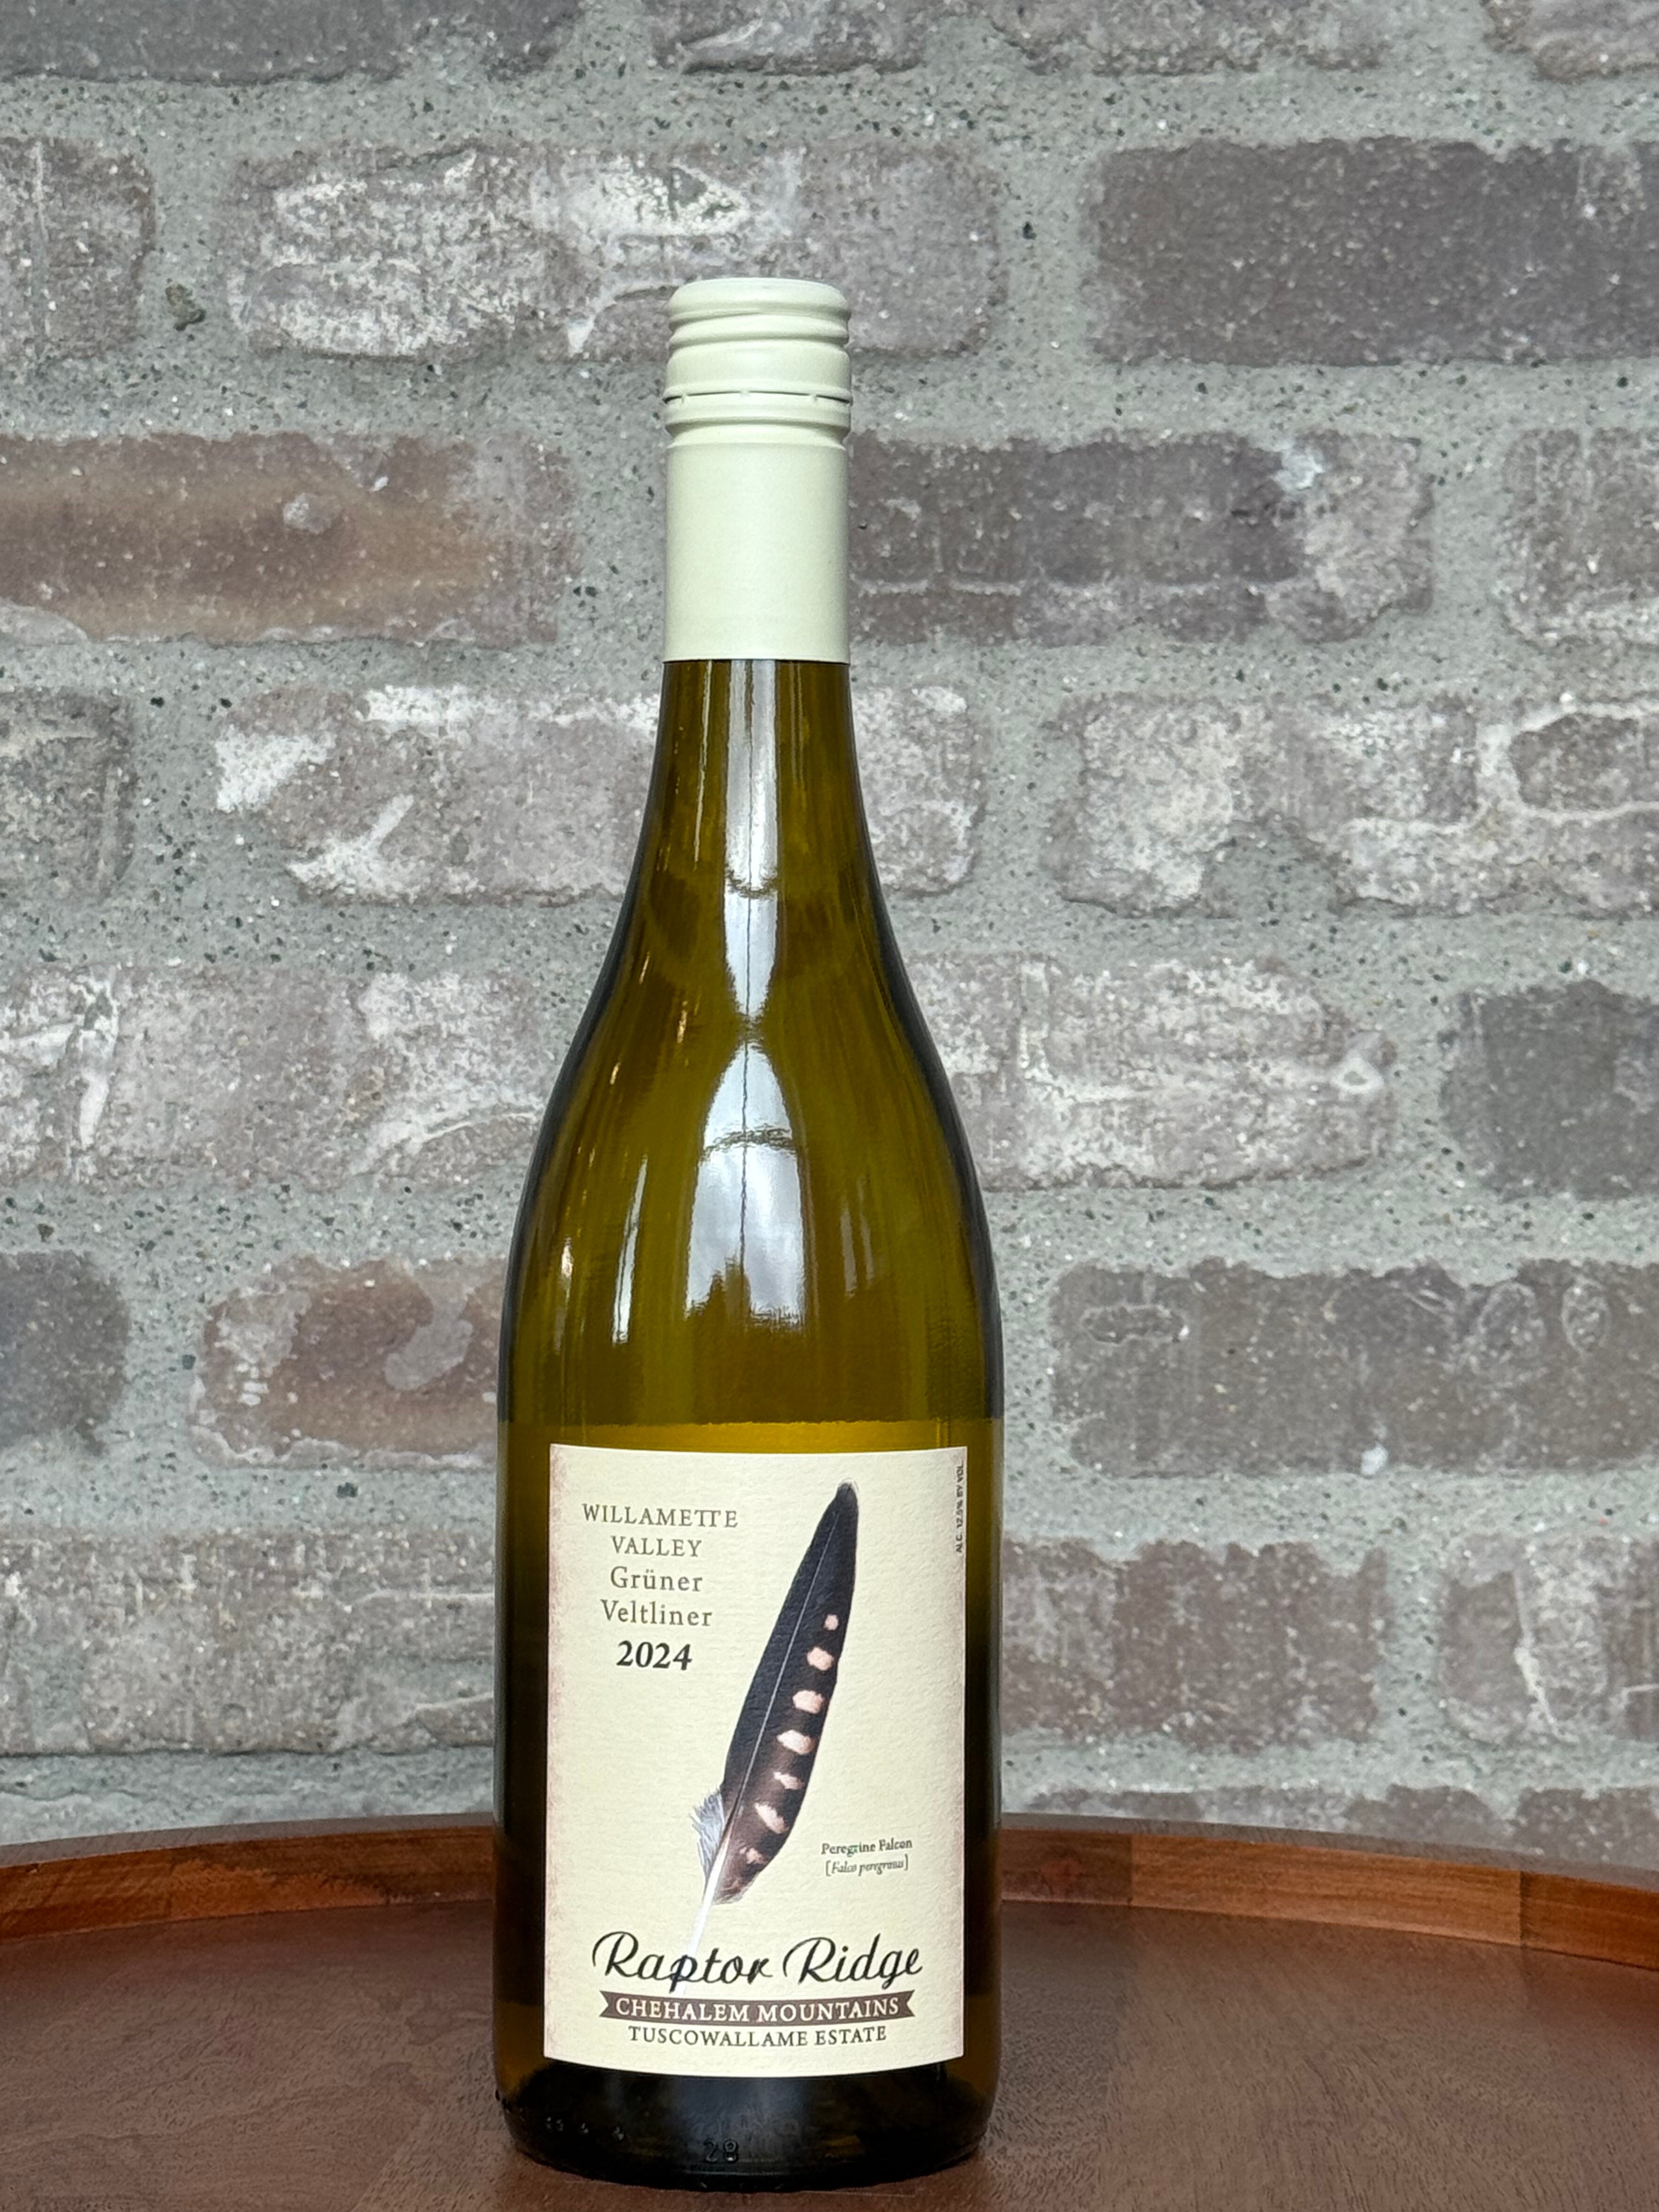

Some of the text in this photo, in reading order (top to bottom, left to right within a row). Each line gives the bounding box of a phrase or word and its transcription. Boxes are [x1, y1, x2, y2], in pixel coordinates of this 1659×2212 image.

[956, 1485, 963, 1498] BY
[582, 1503, 738, 1528] WILLAMETTE
[612, 1536, 702, 1557] VALLEY
[610, 1566, 703, 1592] Grüner
[600, 1599, 713, 1627] Veltliner
[616, 1640, 692, 1671] 2024
[821, 1837, 913, 1858] Peregrine Falcon
[592, 1931, 923, 1994] Raptor Ridge
[616, 1997, 900, 2023] CHEHALEM MOUNTAINS
[629, 2025, 887, 2047] TUSCOWALLAME ESTATE
